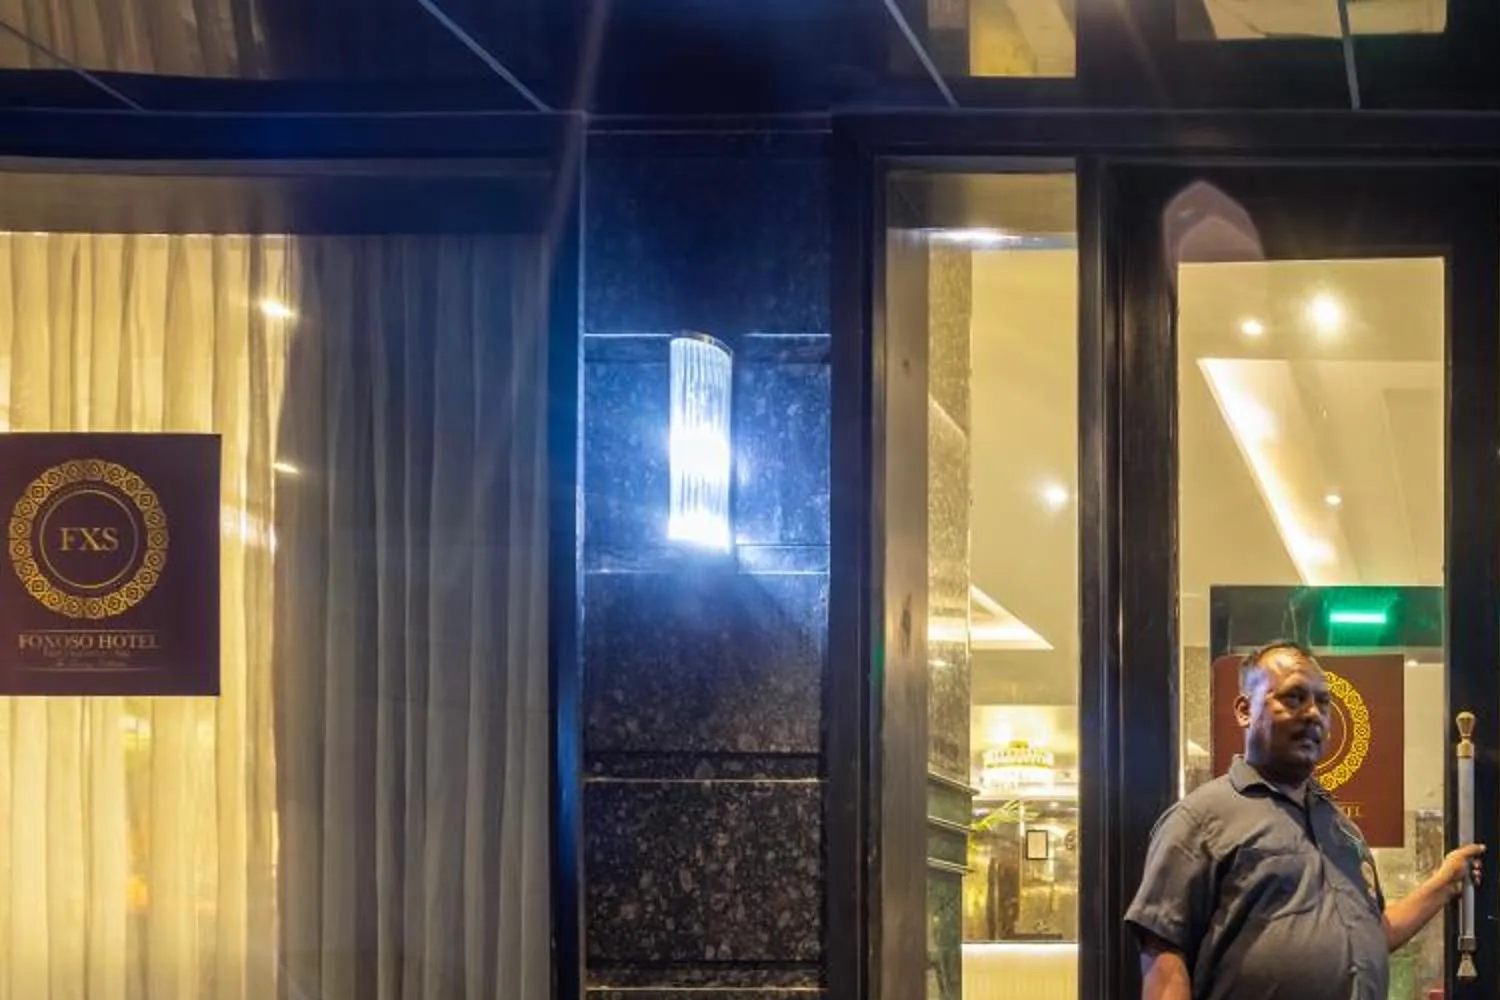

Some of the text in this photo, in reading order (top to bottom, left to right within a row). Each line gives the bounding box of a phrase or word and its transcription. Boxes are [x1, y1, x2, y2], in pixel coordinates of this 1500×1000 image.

[59, 527, 119, 552] FXS
[19, 634, 161, 649] FOXOSO HOTEL
